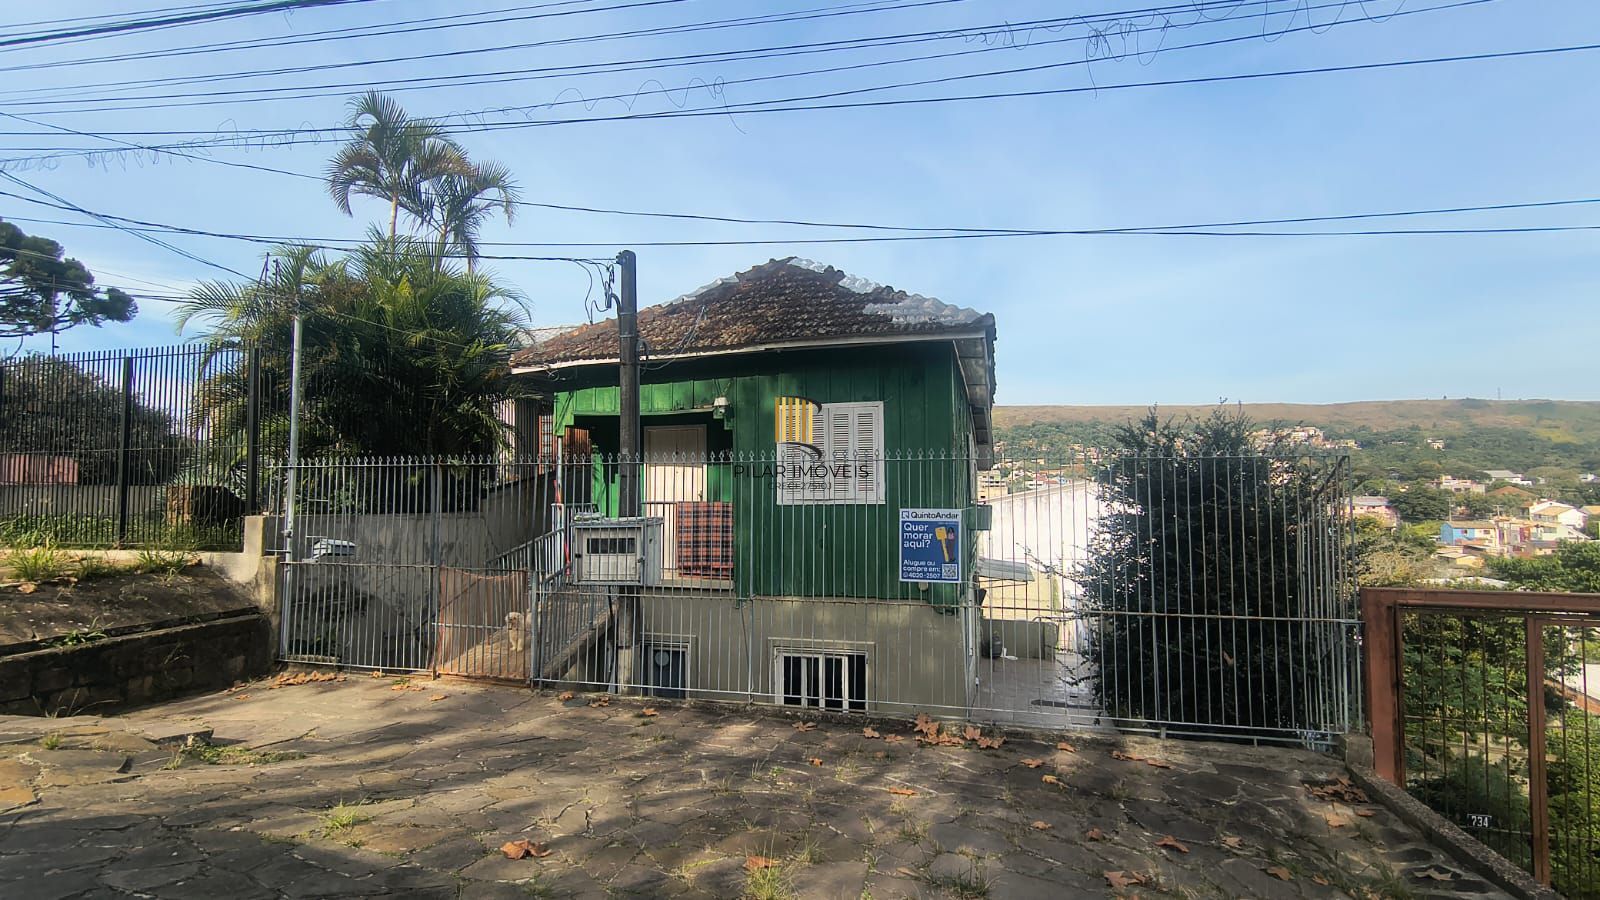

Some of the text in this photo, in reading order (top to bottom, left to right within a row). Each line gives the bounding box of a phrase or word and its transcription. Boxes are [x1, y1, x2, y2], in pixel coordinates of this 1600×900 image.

[911, 511, 959, 520] QuintoAndar
[903, 523, 929, 532] Quer
[903, 540, 931, 549] aqui?
[1471, 815, 1489, 828] 734
